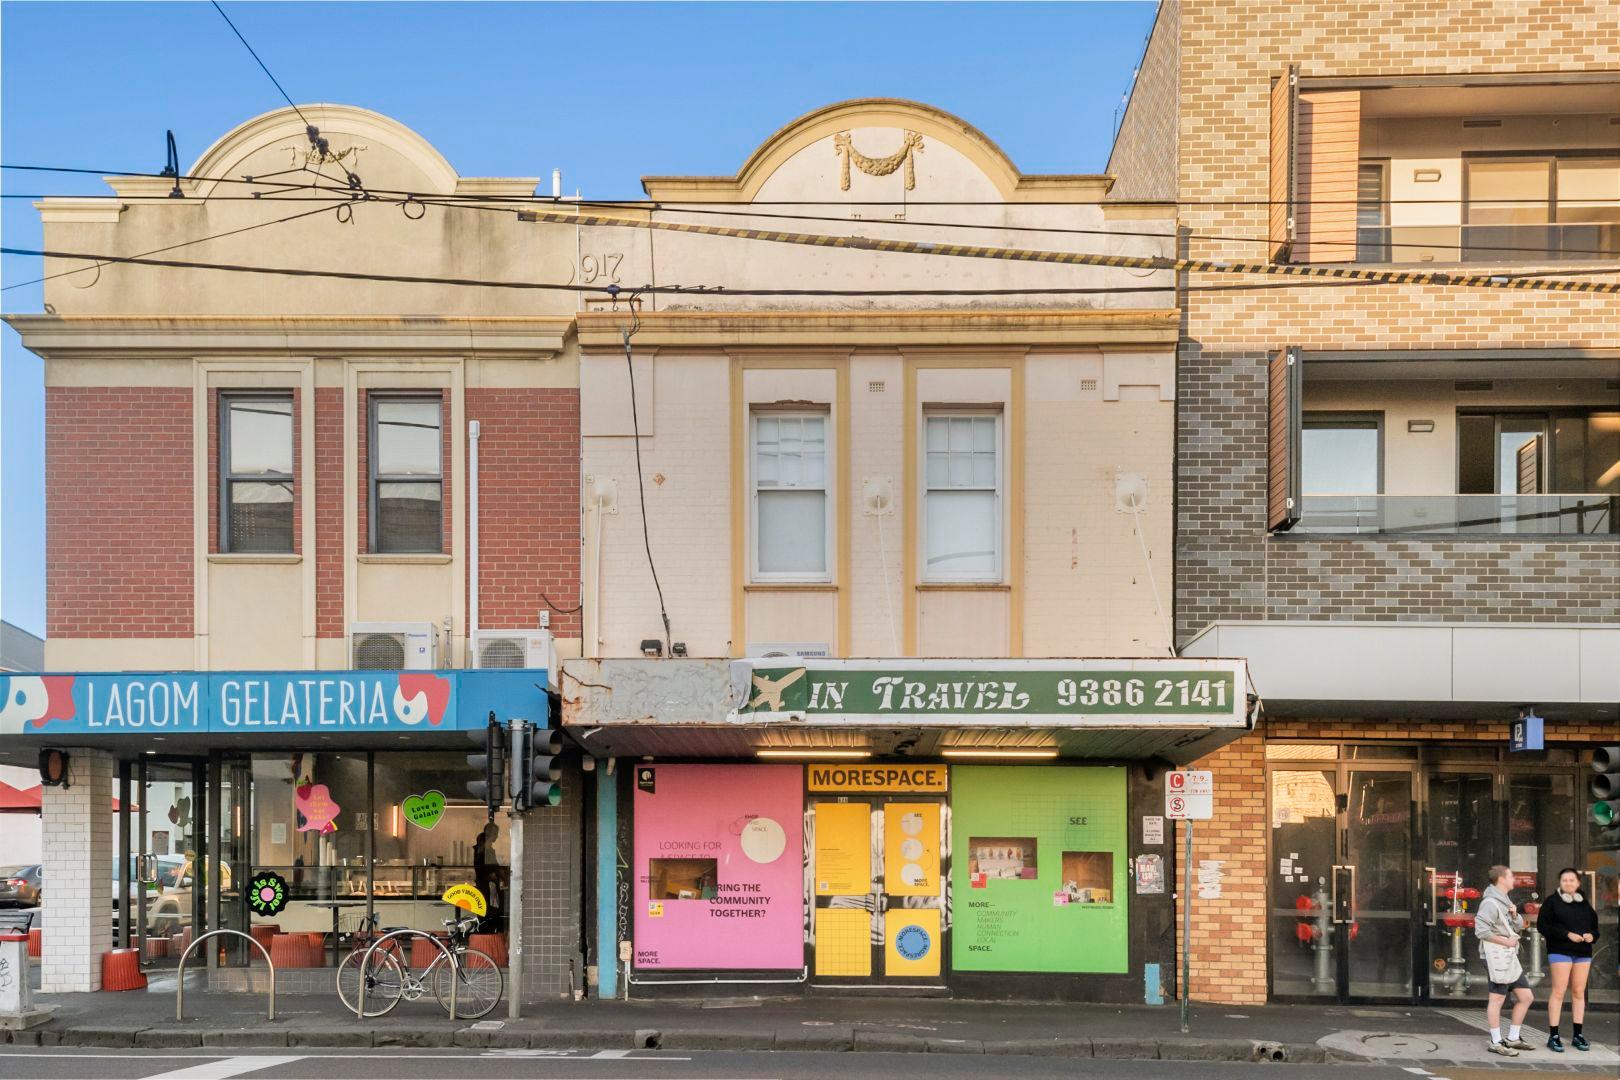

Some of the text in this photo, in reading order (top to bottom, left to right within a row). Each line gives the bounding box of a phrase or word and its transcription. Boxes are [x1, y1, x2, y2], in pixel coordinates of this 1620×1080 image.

[807, 682, 849, 710] IN
[1057, 678, 1145, 707] 9386
[1155, 678, 1226, 707] 2141
[88, 680, 389, 727] LAGOM GELATERIA
[813, 769, 943, 786] MORESPACE.
[411, 804, 431, 813] Love
[413, 809, 439, 820] Gelato
[1069, 817, 1088, 826] SEE
[659, 841, 722, 850] LOOKING FOR
[742, 883, 761, 892] THE
[254, 879, 267, 889] is
[268, 877, 284, 911] Sweet
[709, 896, 771, 905] COMMUNITY
[709, 909, 767, 918] TOGETHER?
